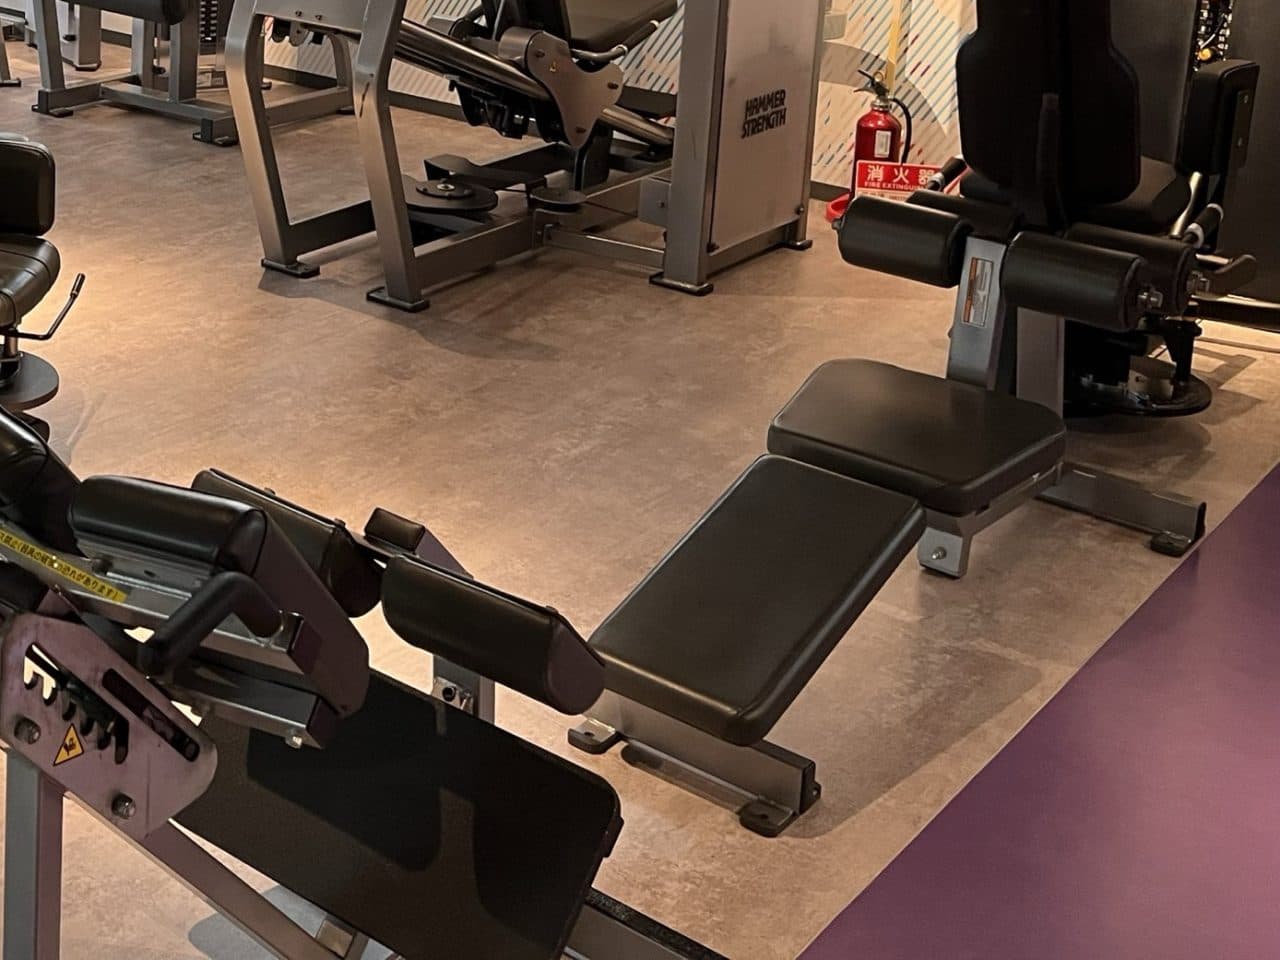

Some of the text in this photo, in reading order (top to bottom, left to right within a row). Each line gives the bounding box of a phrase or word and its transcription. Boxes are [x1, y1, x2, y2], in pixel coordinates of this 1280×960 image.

[745, 89, 787, 119] HAMMER
[740, 107, 787, 139] STRENGTH
[867, 164, 934, 185] 消火器
